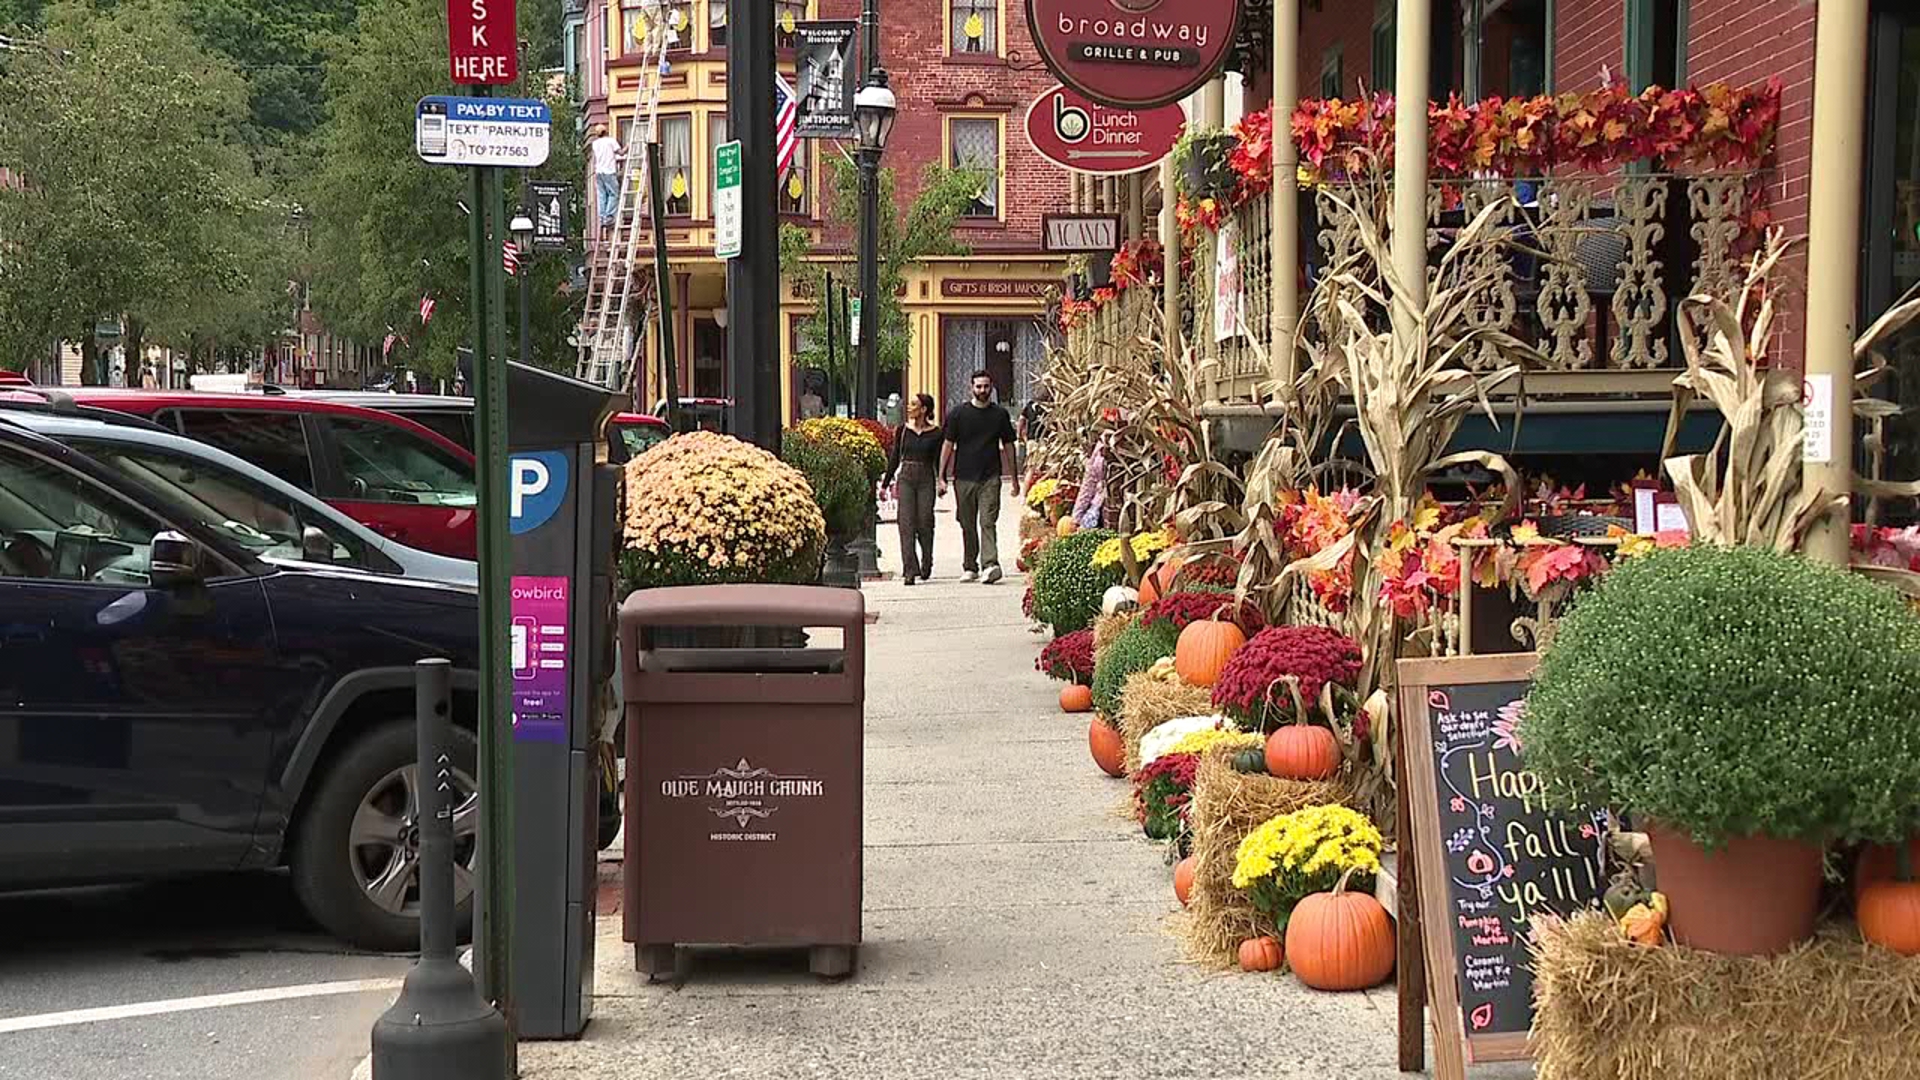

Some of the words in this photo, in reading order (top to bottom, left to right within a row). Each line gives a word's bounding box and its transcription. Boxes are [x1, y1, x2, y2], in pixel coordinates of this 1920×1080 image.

[1058, 12, 1208, 46] broadway
[1083, 46, 1133, 59] GRILLE
[1139, 49, 1148, 60] &
[1154, 50, 1181, 62] PUB
[455, 56, 508, 79] HERE
[457, 104, 485, 117] PAY
[486, 105, 506, 117] BY
[508, 106, 543, 118] TEXT
[1093, 111, 1138, 127] Lunch
[448, 123, 480, 135] TEXT
[1093, 128, 1143, 144] Dinner
[489, 145, 529, 157] 727563
[1046, 222, 1114, 247] VACANCY
[949, 282, 978, 294] GIFTS
[988, 283, 1012, 294] IRISH
[511, 459, 549, 517] P
[1437, 712, 1458, 724] Ask
[1460, 711, 1472, 720] to
[1472, 711, 1489, 720] see
[661, 780, 699, 797] OLDE
[705, 780, 765, 798] MAUCH
[769, 780, 823, 796] CHUNK
[710, 833, 744, 841] HISTORIC
[744, 833, 777, 841] DISTRICT
[1504, 820, 1580, 861] fall
[1458, 900, 1475, 913] Try
[1458, 915, 1500, 928] Pumpkin
[1472, 935, 1509, 947] Martini
[1465, 955, 1504, 968] Caramel
[1466, 967, 1493, 980] Apple
[1472, 979, 1510, 991] Martini
